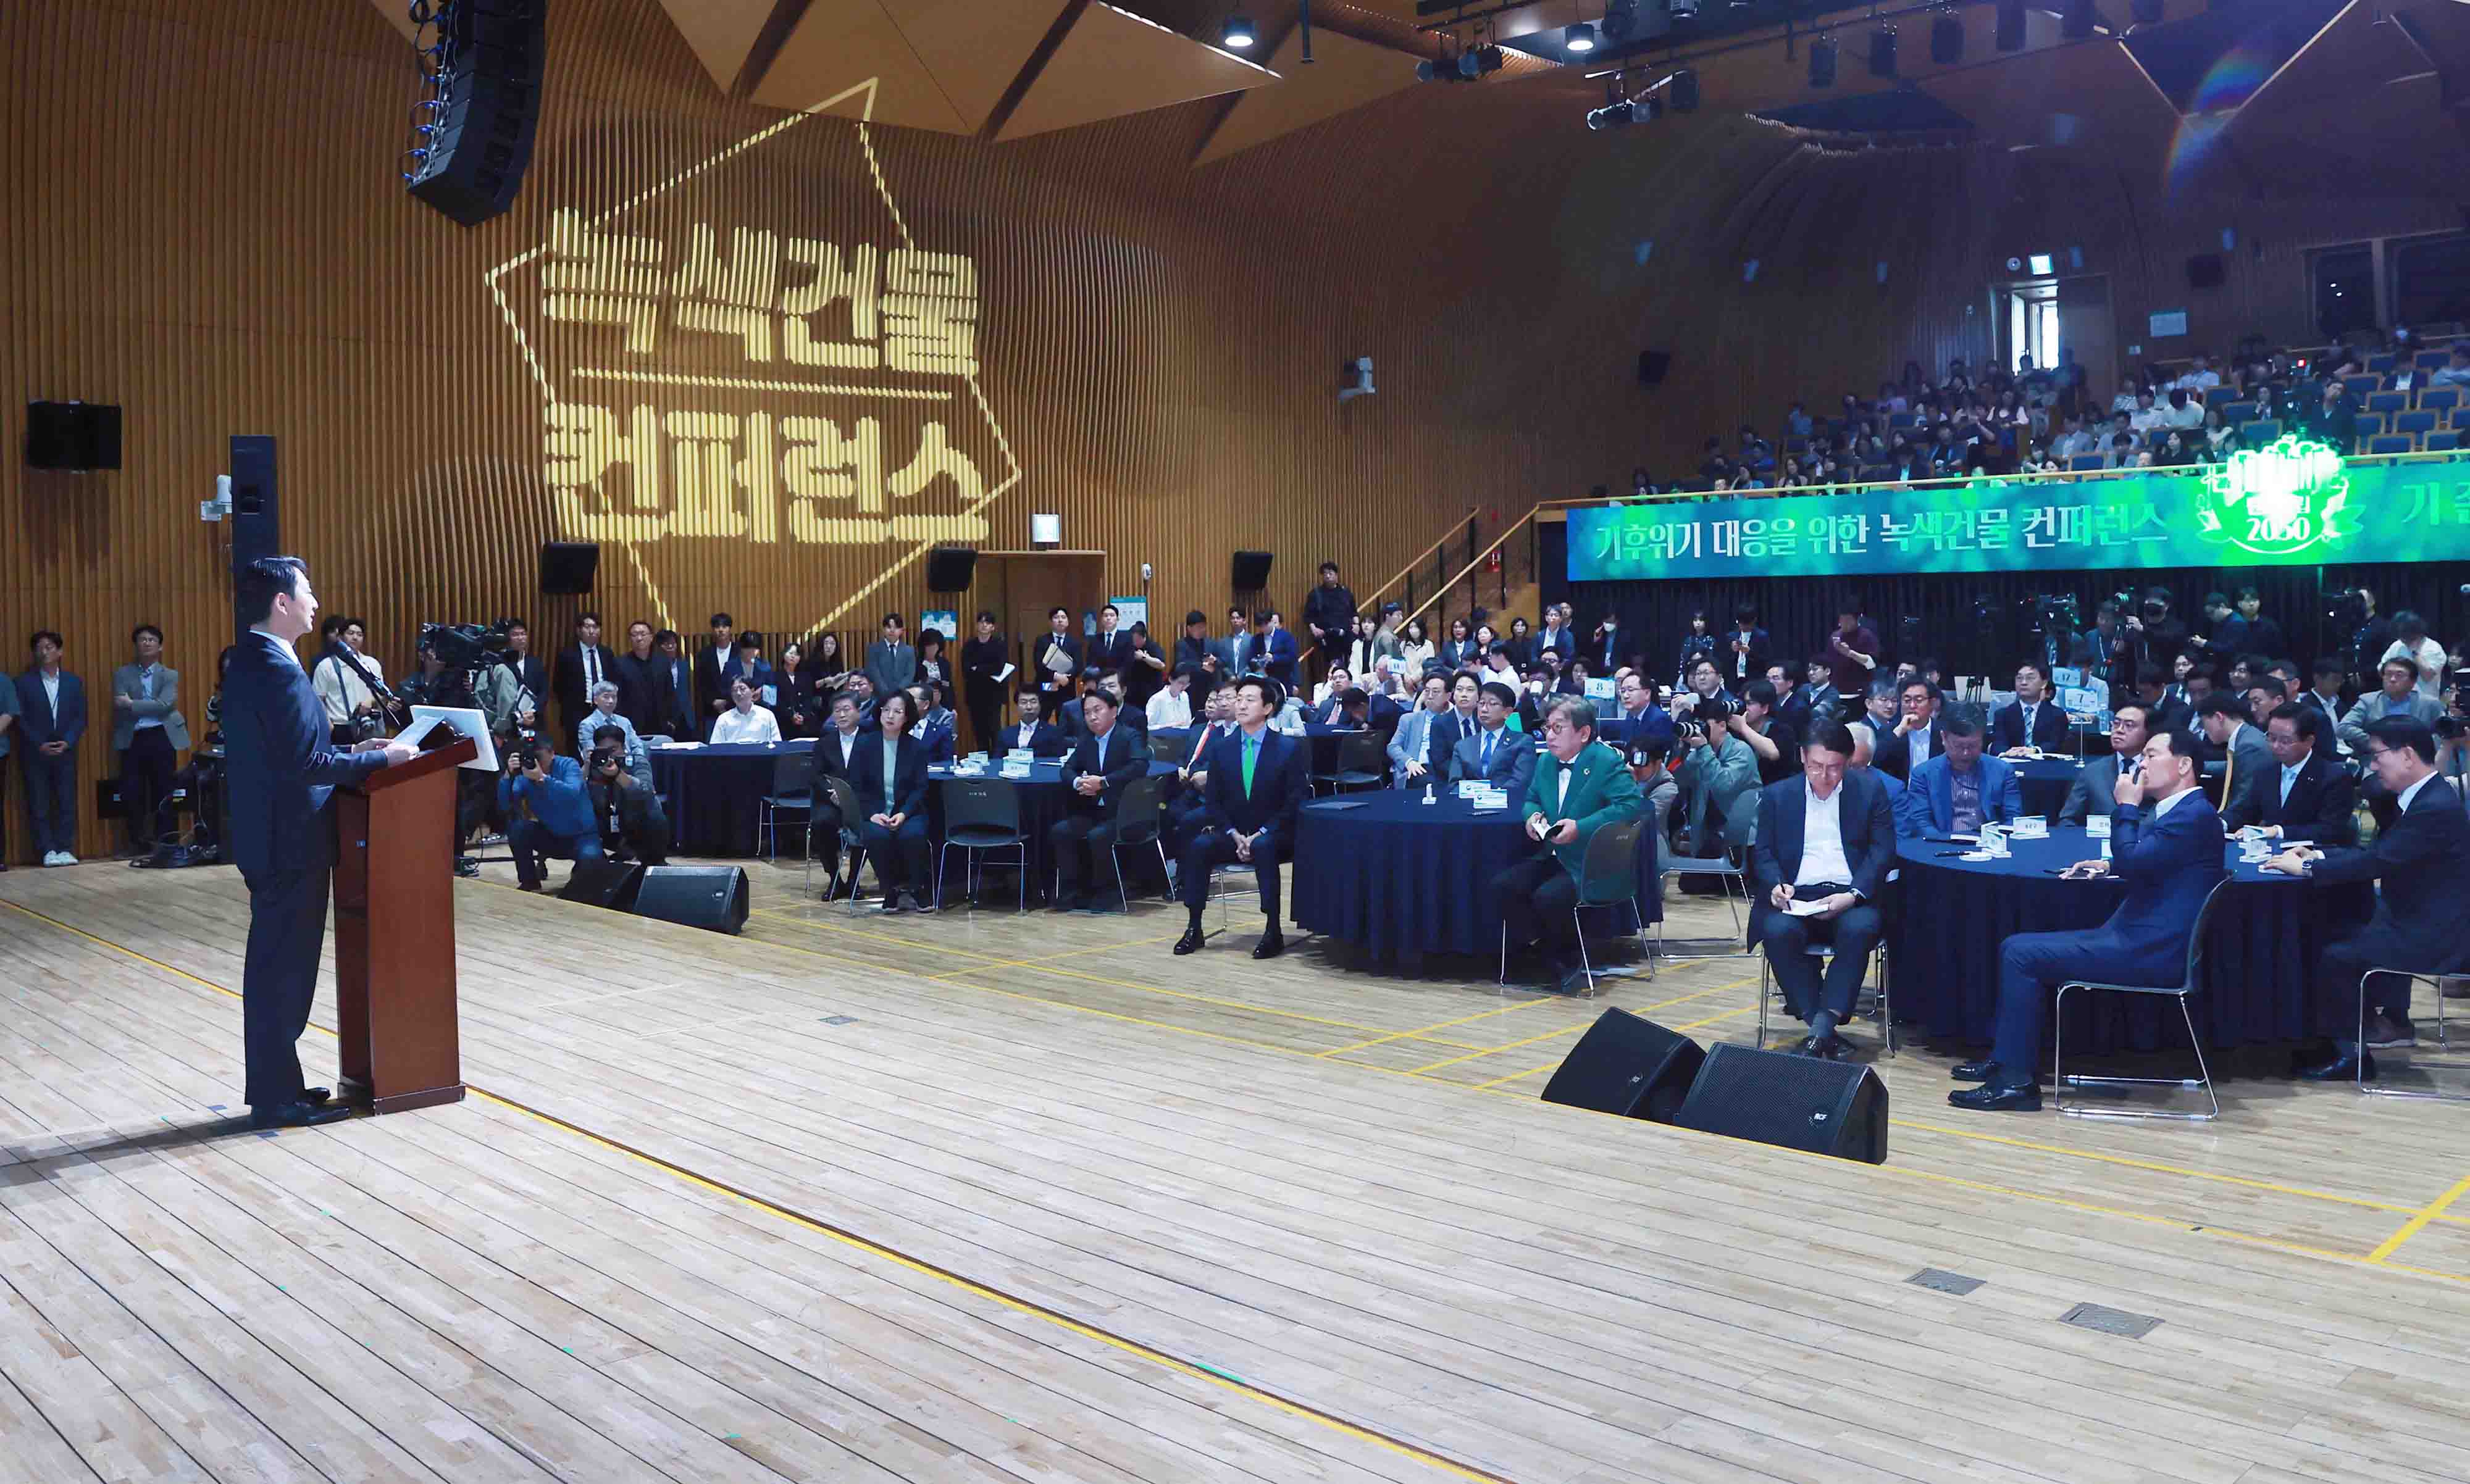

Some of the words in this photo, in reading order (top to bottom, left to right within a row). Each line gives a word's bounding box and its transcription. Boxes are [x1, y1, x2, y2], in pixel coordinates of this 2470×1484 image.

[543, 206, 979, 375] 녹색건물
[544, 402, 989, 543] 컨퍼런스
[1596, 522, 1701, 560] 기후위기
[1711, 518, 1798, 557] 대응을
[1808, 514, 1870, 554] 위한
[1880, 509, 2011, 551] 녹색건물
[2022, 503, 2167, 548] 컨퍼런스
[1596, 682, 1604, 691] 8
[2077, 693, 2084, 704] 7
